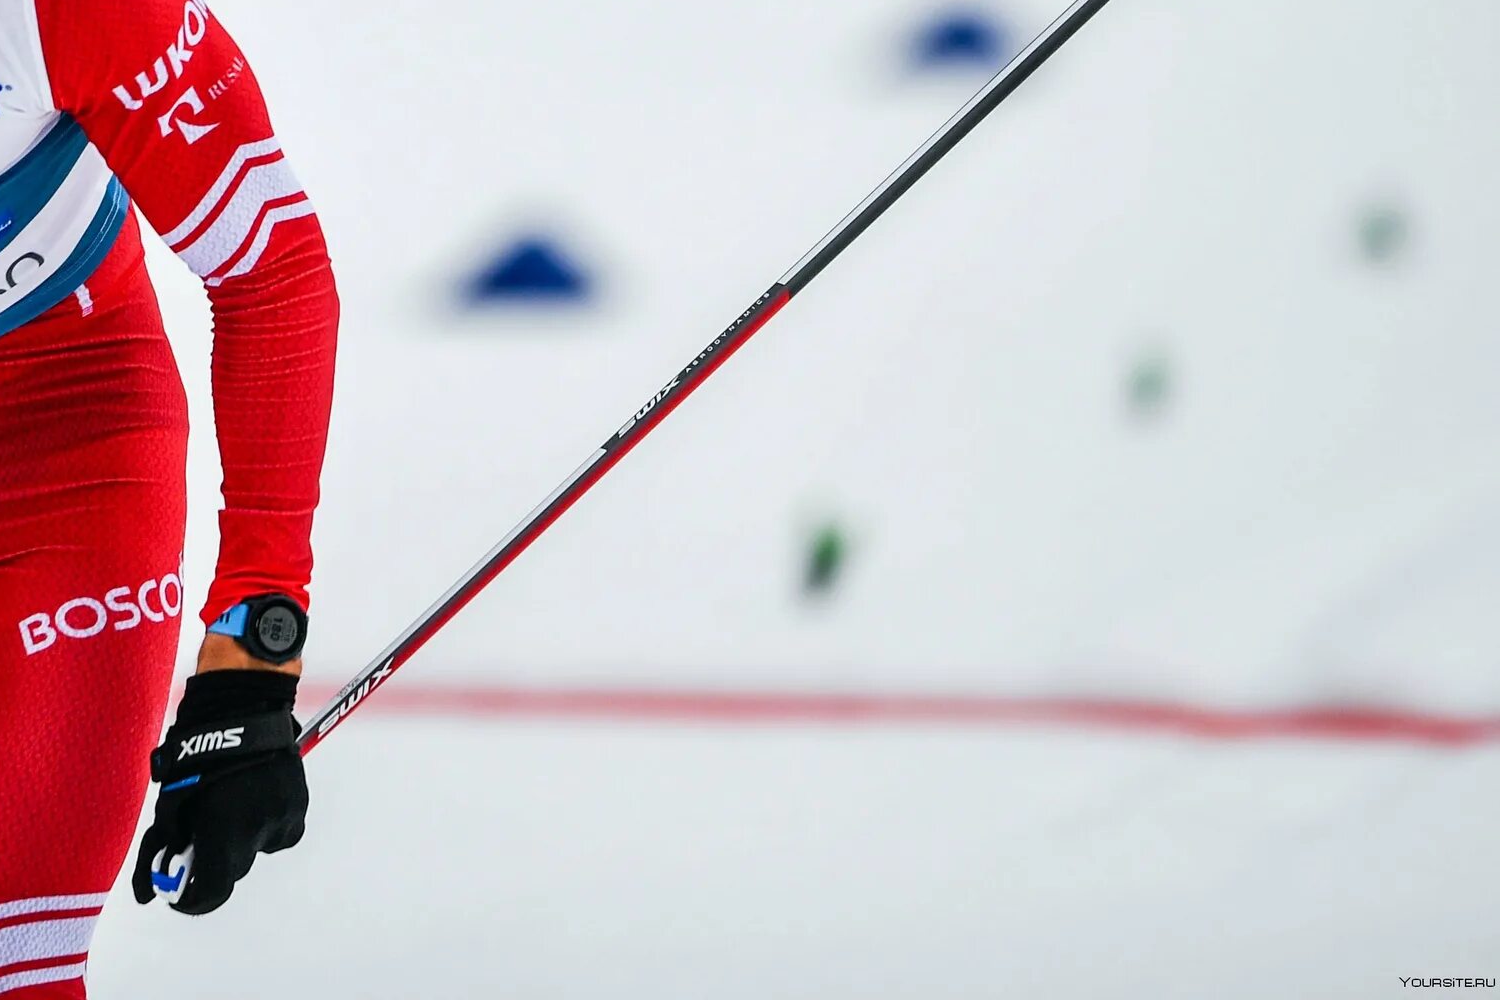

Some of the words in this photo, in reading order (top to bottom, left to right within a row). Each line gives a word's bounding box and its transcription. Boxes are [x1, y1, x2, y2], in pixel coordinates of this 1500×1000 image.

[18, 572, 182, 656] BOSCO
[317, 656, 395, 740] SWIX
[177, 726, 245, 762] SWIX
